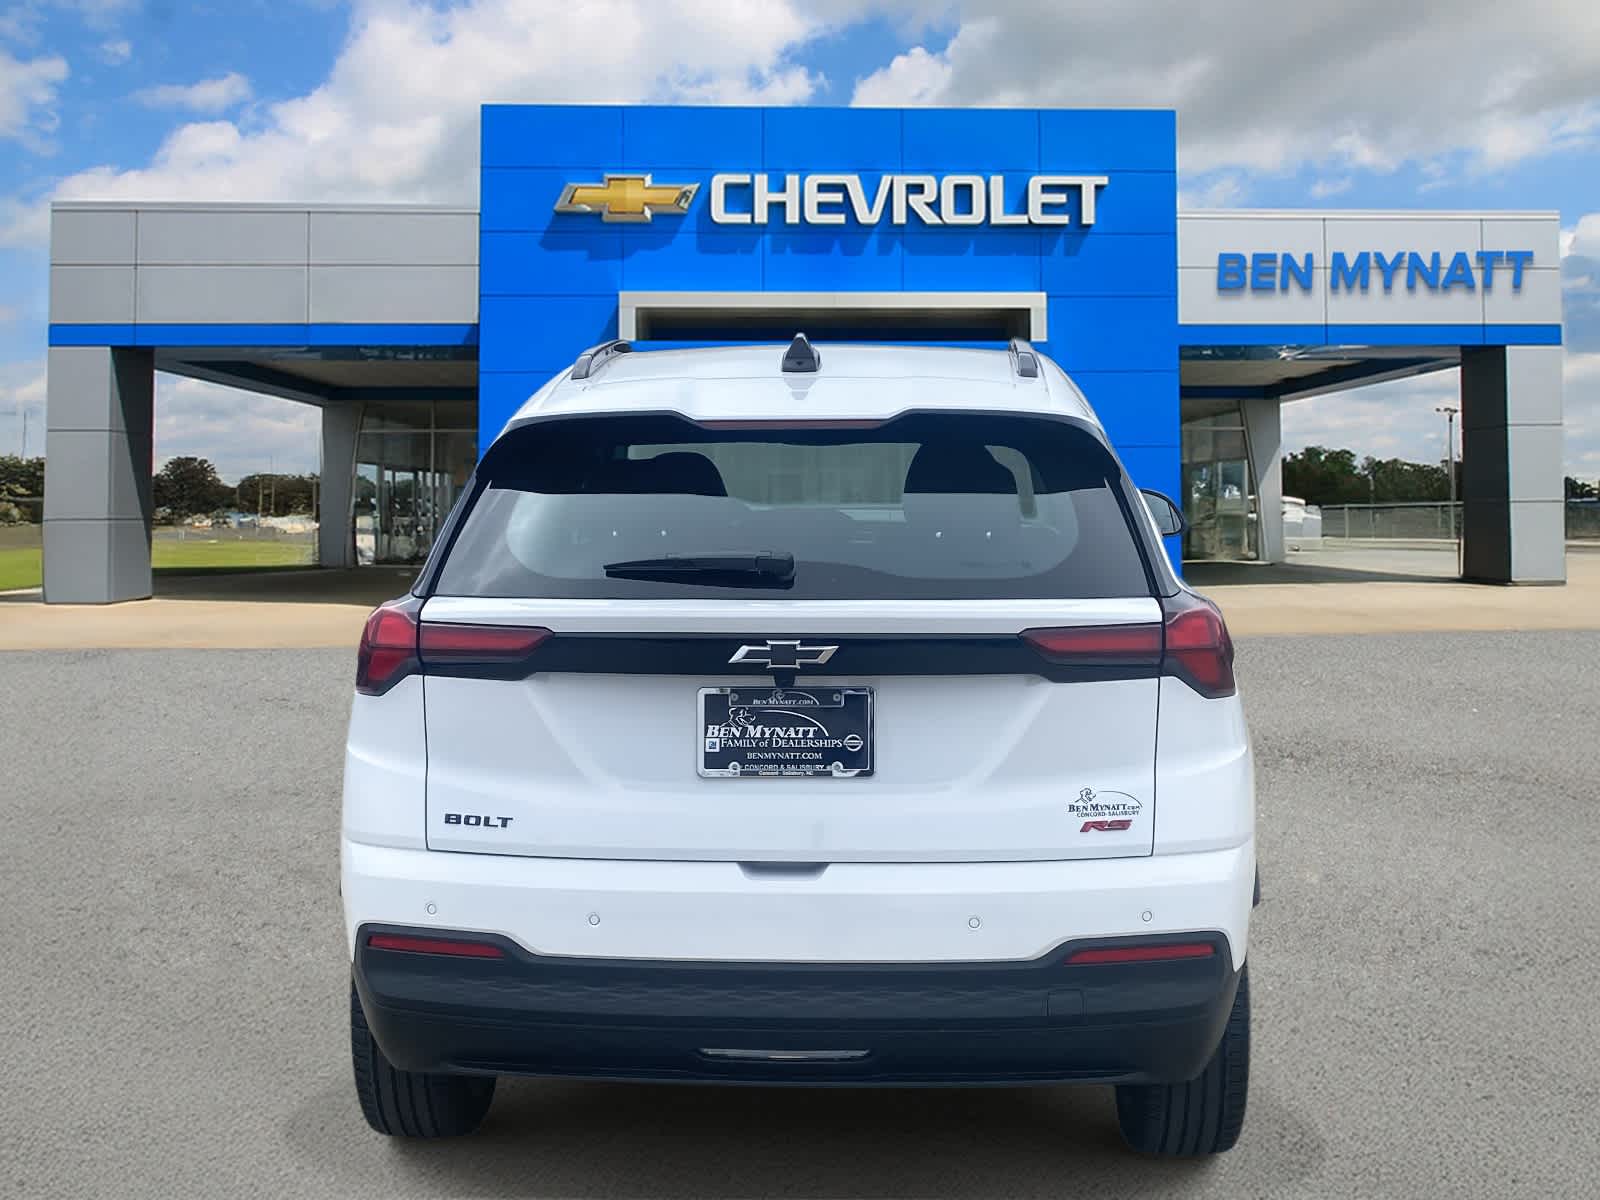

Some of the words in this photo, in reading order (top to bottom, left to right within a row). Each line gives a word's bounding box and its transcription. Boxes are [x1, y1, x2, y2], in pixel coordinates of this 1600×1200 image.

[709, 173, 1110, 226] CHEVROLET
[1217, 252, 1313, 292] BEN
[1330, 250, 1534, 290] MYNATT
[706, 725, 743, 738] BEN
[745, 725, 818, 738] MYNATT
[721, 738, 758, 748] FAMILY
[759, 739, 770, 748] of
[772, 738, 843, 748] DEALERSHIPS
[747, 752, 822, 760] BENMYNATT.COM
[444, 813, 514, 828] BOLT
[1079, 819, 1133, 832] RS
